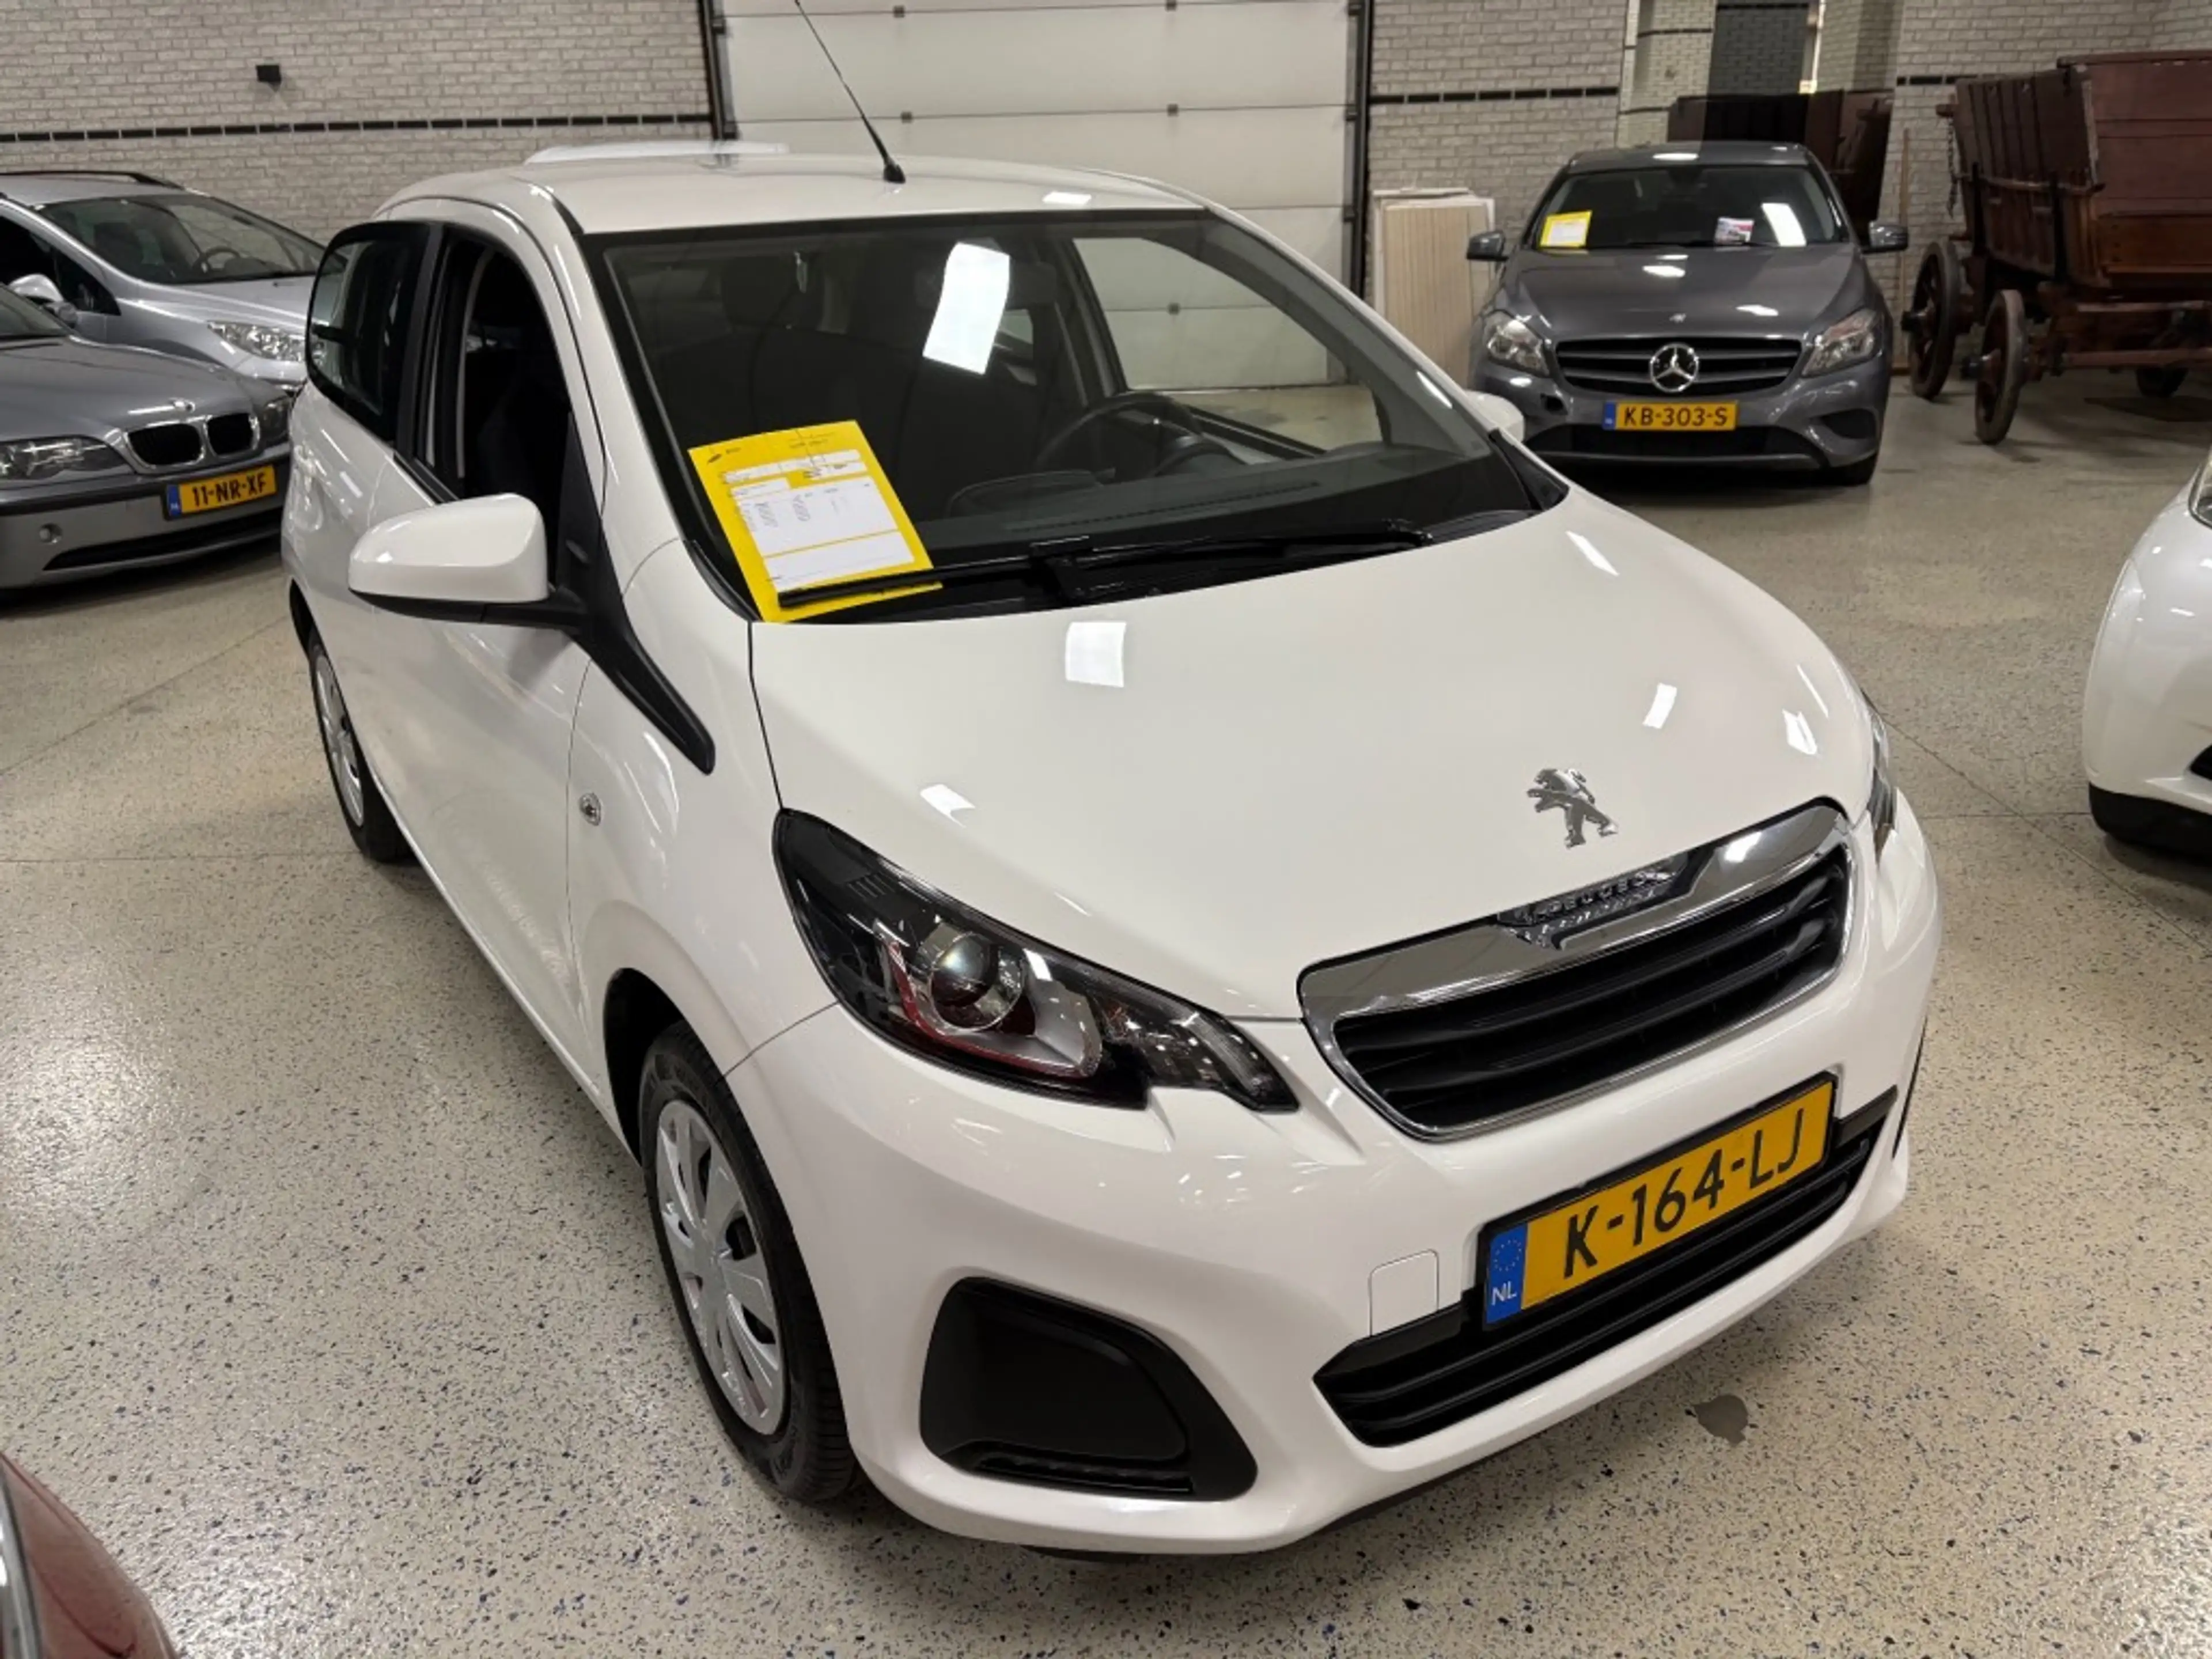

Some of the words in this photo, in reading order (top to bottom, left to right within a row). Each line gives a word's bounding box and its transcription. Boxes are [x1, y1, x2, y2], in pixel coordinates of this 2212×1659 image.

[1624, 406, 1727, 426] KB-303-S
[192, 472, 266, 507] 11-NR-XF
[1563, 1108, 1804, 1278] K-164-LJ
[1491, 1281, 1517, 1306] NL
